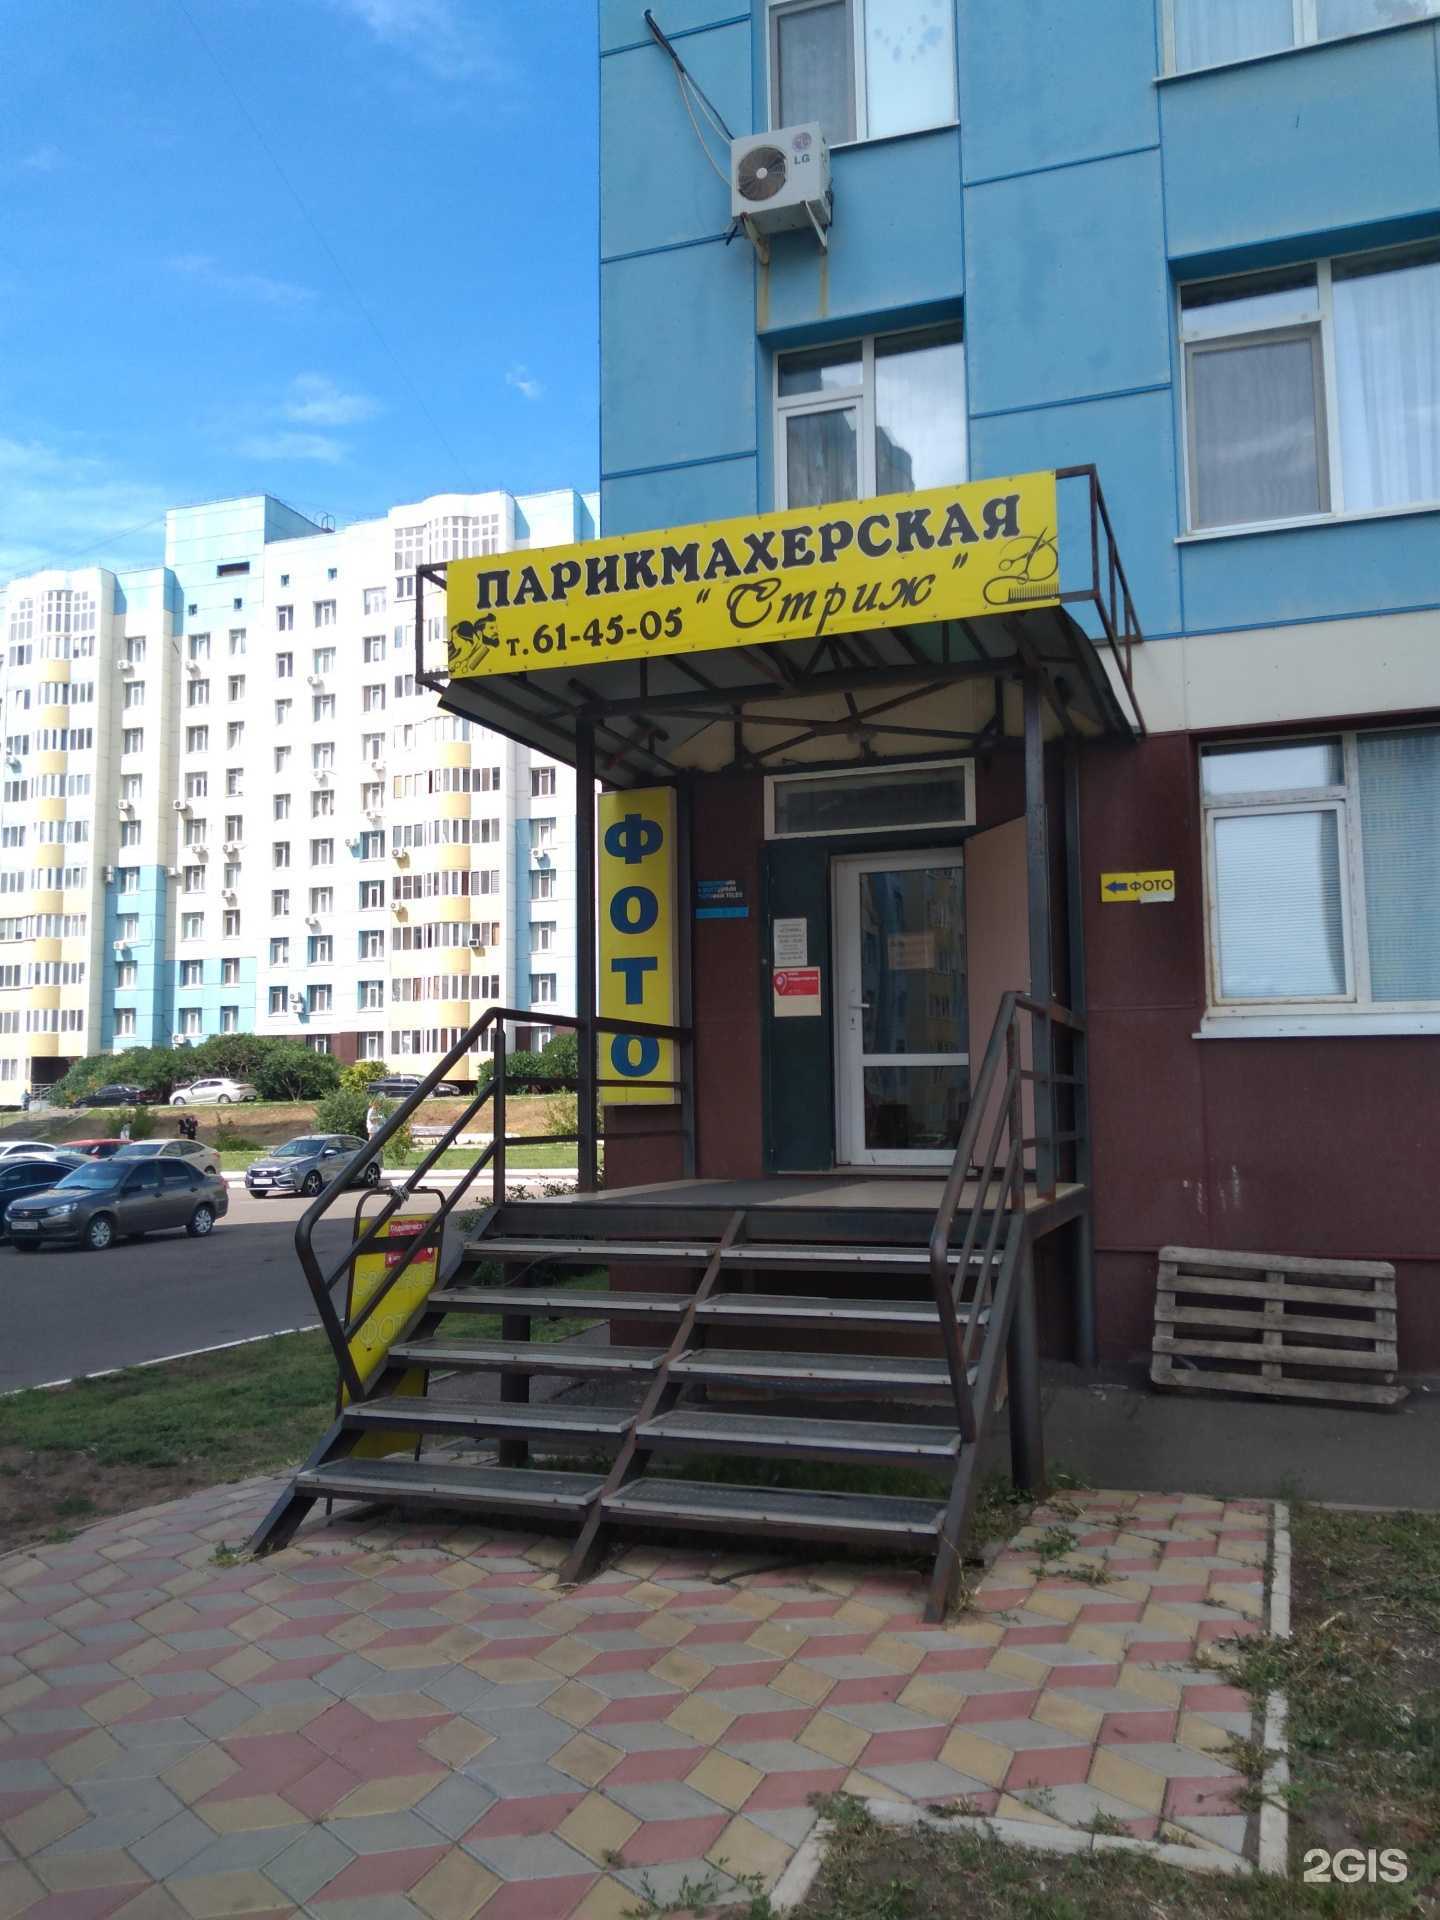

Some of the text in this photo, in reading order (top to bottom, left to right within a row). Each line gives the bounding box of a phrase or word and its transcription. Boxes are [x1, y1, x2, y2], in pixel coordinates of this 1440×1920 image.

[794, 153, 811, 165] LG
[476, 494, 1020, 610] ПАРИКМАХЕРСКАЯ
[1130, 879, 1174, 892] ФОТО
[603, 813, 664, 1078] ФОТО
